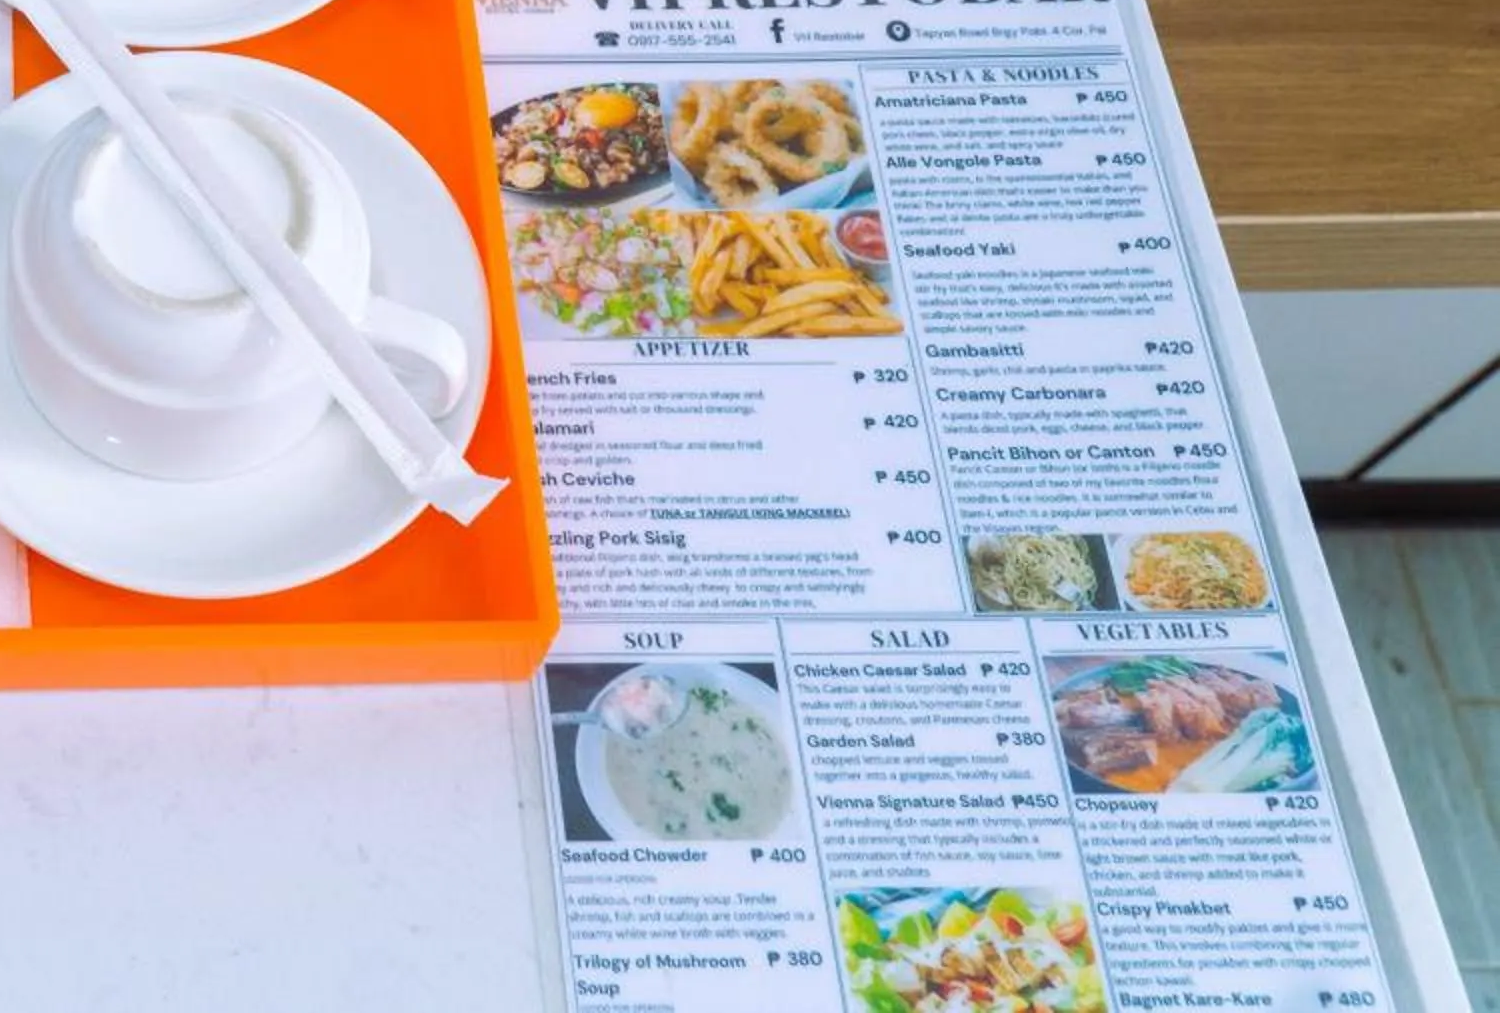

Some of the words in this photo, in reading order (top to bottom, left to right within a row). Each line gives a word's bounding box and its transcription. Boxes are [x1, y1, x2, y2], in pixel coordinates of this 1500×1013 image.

[629, 20, 694, 30] DELIVERY
[699, 19, 734, 30] CALL
[908, 68, 973, 84] PASTA
[982, 68, 996, 82] &
[1002, 66, 1100, 83] NOODLES
[875, 93, 976, 108] Amatriciana
[980, 93, 1028, 106] Pasta
[1094, 90, 1128, 103] 450
[886, 155, 918, 169] Alle
[920, 155, 991, 171] Vongole
[994, 154, 1043, 167] Pasta
[903, 242, 975, 258] Seafood
[978, 241, 1016, 256] Yaki
[635, 341, 749, 357] APPETIZER
[925, 343, 1025, 358] Gambasitti
[527, 372, 570, 385] ench
[574, 371, 617, 385] Fries
[873, 368, 909, 382] 320
[936, 388, 1007, 405] Creamy
[1011, 386, 1107, 401] Carbonara
[884, 414, 919, 428] 420
[947, 446, 1005, 461] Pancit
[1008, 446, 1061, 460] Bihon
[1065, 448, 1083, 460] or
[1087, 444, 1156, 460] Canton
[562, 472, 636, 486] Ceviche
[894, 470, 931, 484] 450
[599, 530, 639, 545] Pork
[644, 529, 687, 549] Sisig
[871, 630, 949, 648] SALAD
[1077, 621, 1229, 641] VEGETABLES
[623, 631, 684, 650] SOUP
[793, 664, 859, 678] Chicken
[863, 664, 918, 677] Caesar
[922, 662, 967, 676] Salad
[998, 662, 1031, 675] 420
[806, 734, 868, 748] Garden
[870, 733, 916, 748] Salad
[816, 795, 875, 809] Vienna
[877, 794, 956, 811] Signature
[959, 794, 1004, 808] Salad
[1075, 797, 1159, 813] Chopsuey
[1284, 795, 1319, 810] 420
[561, 849, 629, 863] Seafood
[633, 848, 708, 862] Chowder
[769, 848, 806, 863] 400
[1098, 901, 1151, 918] Crispy
[1155, 901, 1231, 916] Pinakbet
[1312, 895, 1349, 910] 450
[574, 954, 631, 973] Trilogy
[635, 954, 651, 969] of
[655, 954, 746, 969] Mushroom
[787, 950, 824, 967] 380
[577, 980, 620, 999] Soup
[1120, 992, 1180, 1009] Bagnet
[1184, 991, 1272, 1007] Kare-Kare
[1338, 990, 1376, 1007] 480
